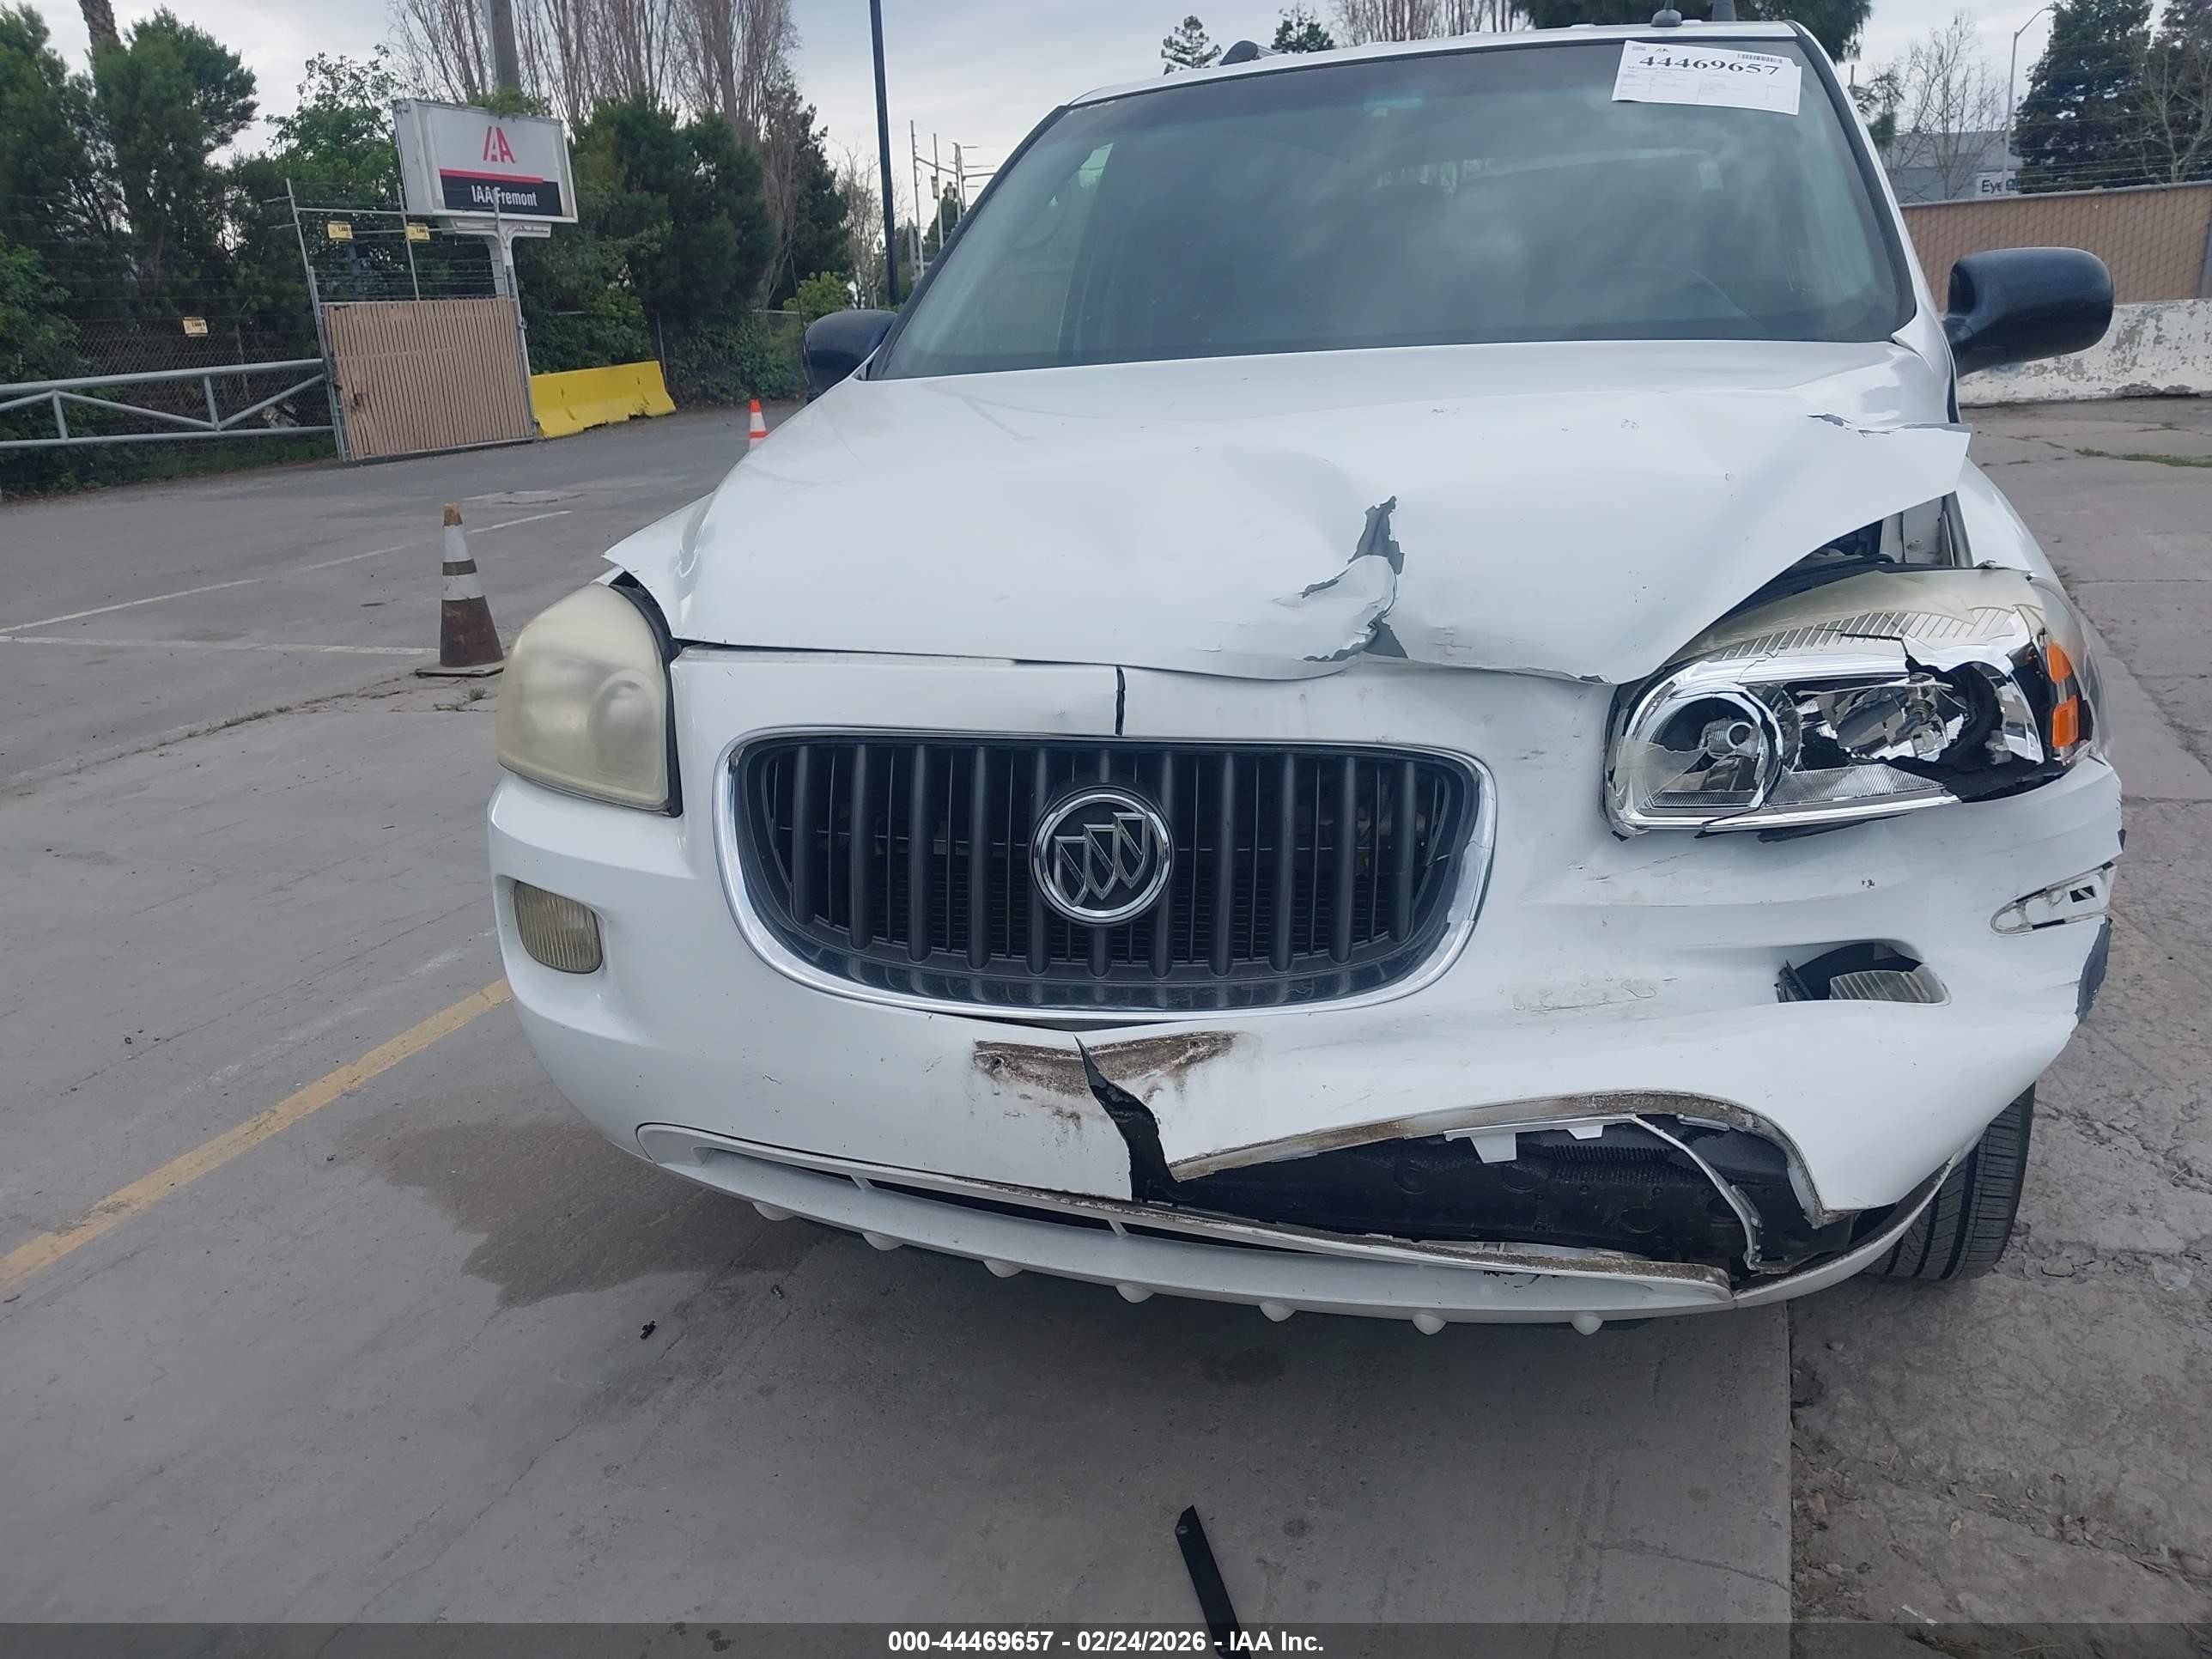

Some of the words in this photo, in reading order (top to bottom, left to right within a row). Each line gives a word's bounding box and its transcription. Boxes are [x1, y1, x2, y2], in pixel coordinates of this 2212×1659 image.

[1638, 55, 1780, 76] 44469657
[471, 185, 494, 204] IAA
[495, 186, 538, 207] Fremont
